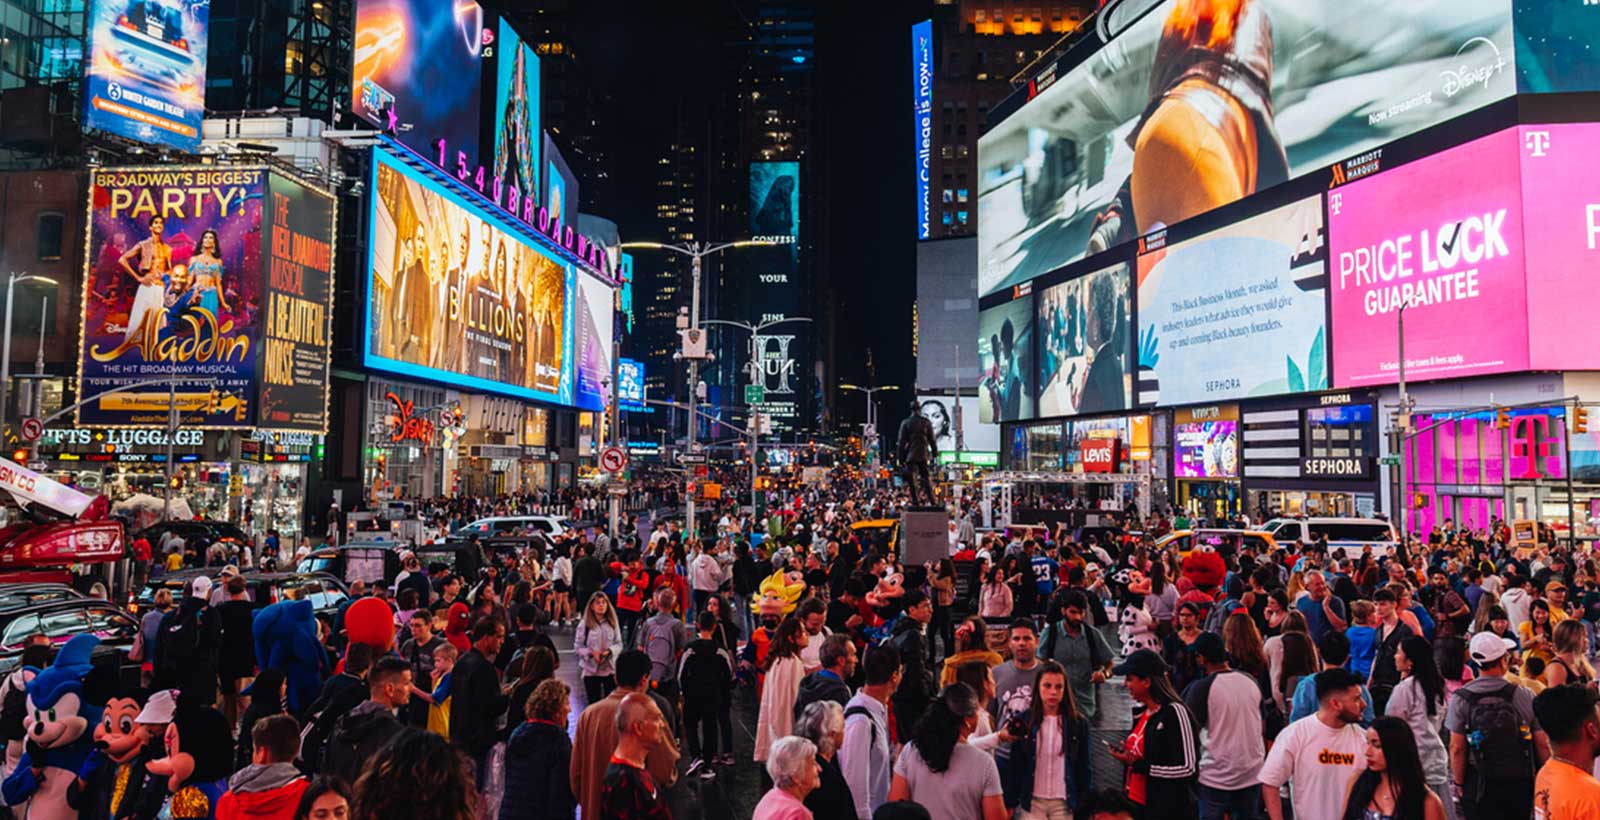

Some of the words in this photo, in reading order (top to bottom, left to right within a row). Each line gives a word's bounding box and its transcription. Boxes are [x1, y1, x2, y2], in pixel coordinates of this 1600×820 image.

[1368, 112, 1389, 126] Now
[1388, 92, 1433, 118] streaming
[919, 116, 931, 183] College
[1347, 149, 1383, 169] MARRIOTT
[96, 171, 193, 188] BROADWAY'S
[196, 170, 261, 185] BIGGEST
[1347, 160, 1380, 180] MARQUIS
[110, 186, 247, 219] PARTY!
[274, 191, 289, 228] THE
[438, 138, 502, 202] 1540
[508, 185, 608, 269] BROADWAY
[751, 236, 796, 244] CONFESS
[1340, 234, 1413, 290] PRICE
[1421, 208, 1509, 273] LOCK
[760, 274, 788, 283] YOUR
[1364, 268, 1480, 316] GUARANTEE
[267, 291, 275, 337] A
[276, 293, 326, 347] BEAUTIFUL
[450, 286, 524, 343] BILLIONS
[761, 314, 784, 323] SINS
[90, 306, 249, 363] Aladdin
[103, 365, 121, 374] THE
[123, 365, 138, 374] HIT
[140, 365, 193, 374] BROADWAY
[196, 365, 237, 374] MUSICAL
[264, 337, 294, 386] NOISE
[227, 379, 250, 387] AWAY
[1205, 379, 1241, 393] SEPHORA
[1320, 394, 1351, 406] SEPHORA
[119, 452, 147, 461] SONY
[1304, 459, 1362, 475] SEPHORA
[1032, 564, 1051, 582] 23
[1319, 747, 1355, 765] drew
